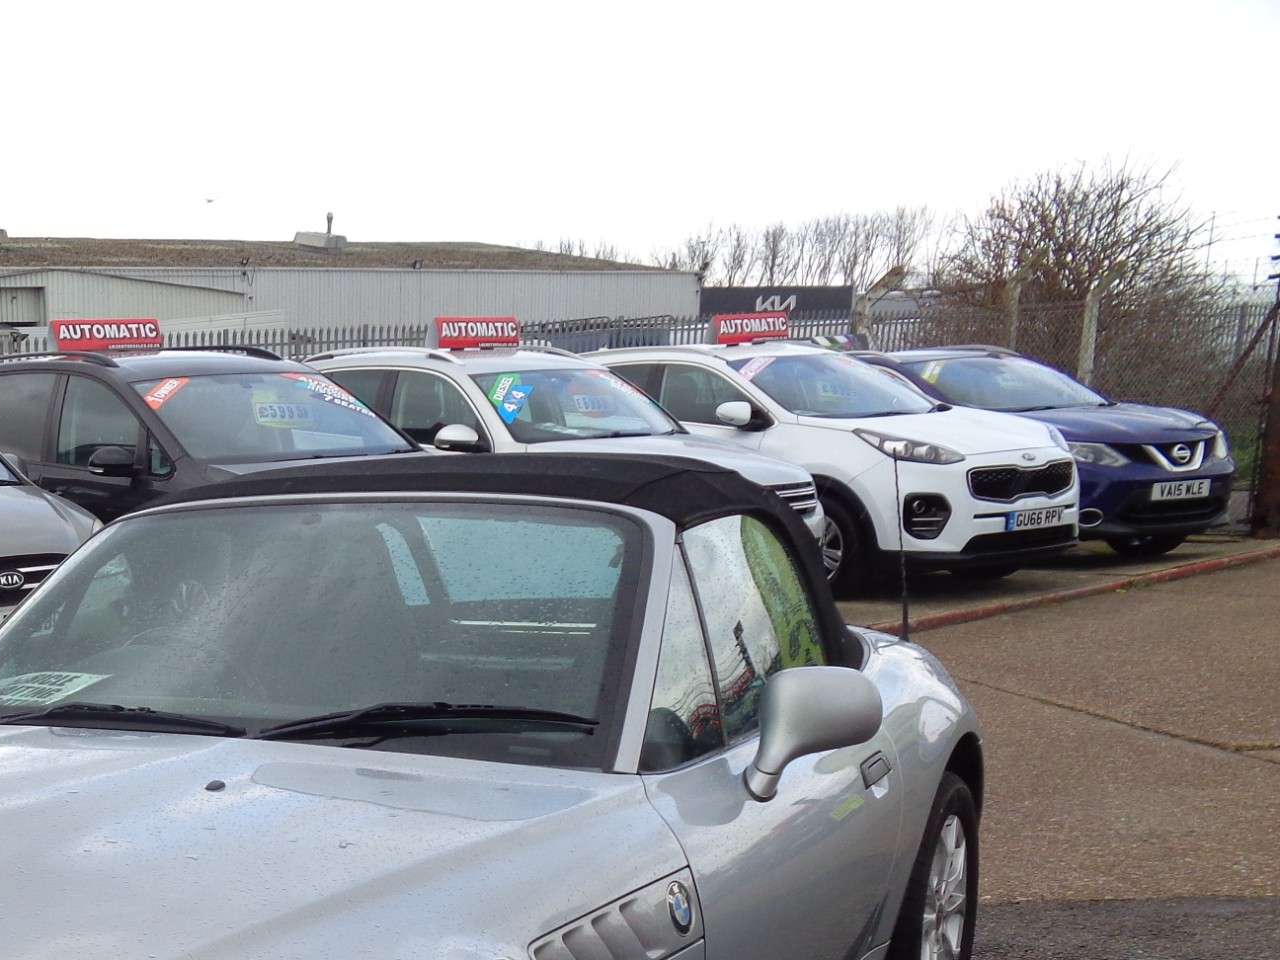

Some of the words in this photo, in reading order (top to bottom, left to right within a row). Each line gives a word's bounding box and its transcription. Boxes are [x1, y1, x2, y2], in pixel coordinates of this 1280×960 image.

[755, 295, 797, 311] KIA
[59, 323, 157, 339] AUTOMATIC
[442, 322, 517, 337] AUTOMATIC
[720, 317, 787, 334] AUTOMATIC
[1160, 484, 1182, 497] VA15
[1184, 481, 1204, 496] WLE
[1016, 511, 1043, 527] GU66
[1044, 507, 1064, 525] RPV
[0, 574, 20, 585] KIA
